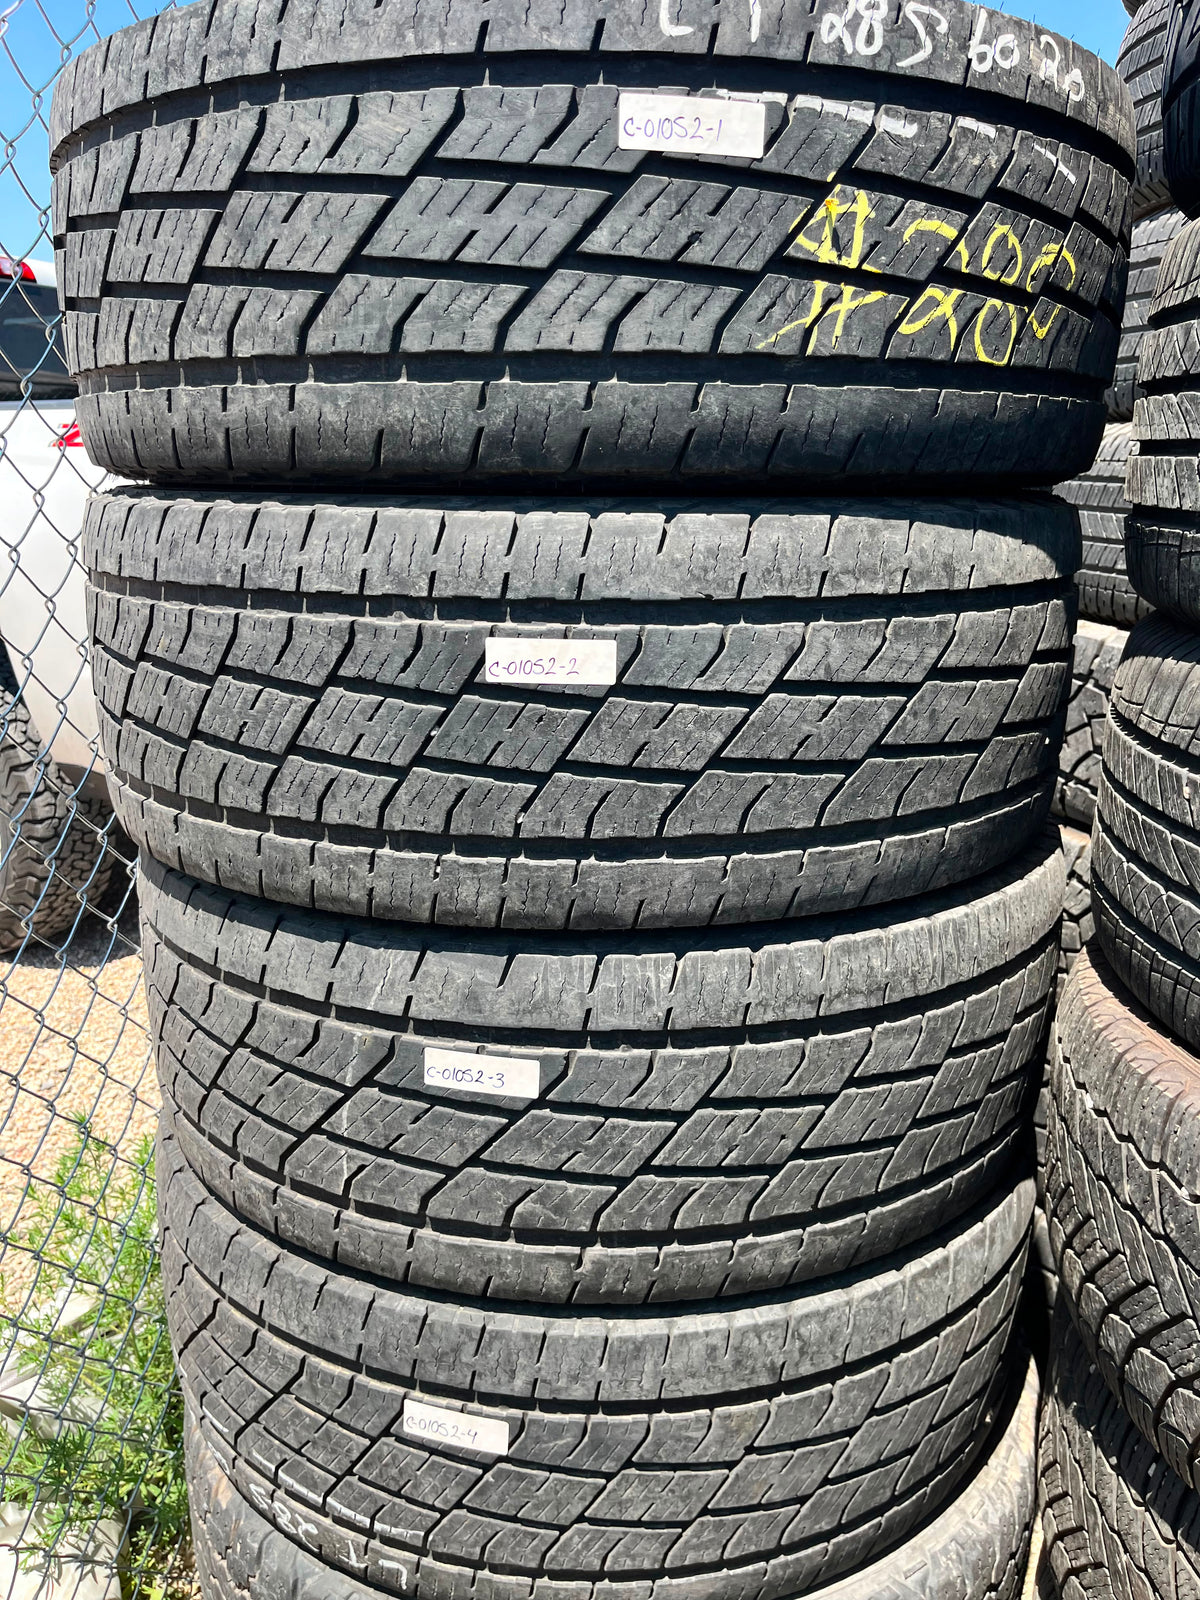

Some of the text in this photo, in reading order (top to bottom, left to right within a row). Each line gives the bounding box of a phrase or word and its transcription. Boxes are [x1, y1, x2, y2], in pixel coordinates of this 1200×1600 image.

[819, 0, 949, 68] 285
[968, 8, 1020, 74] 60
[1039, 33, 1085, 102] 20
